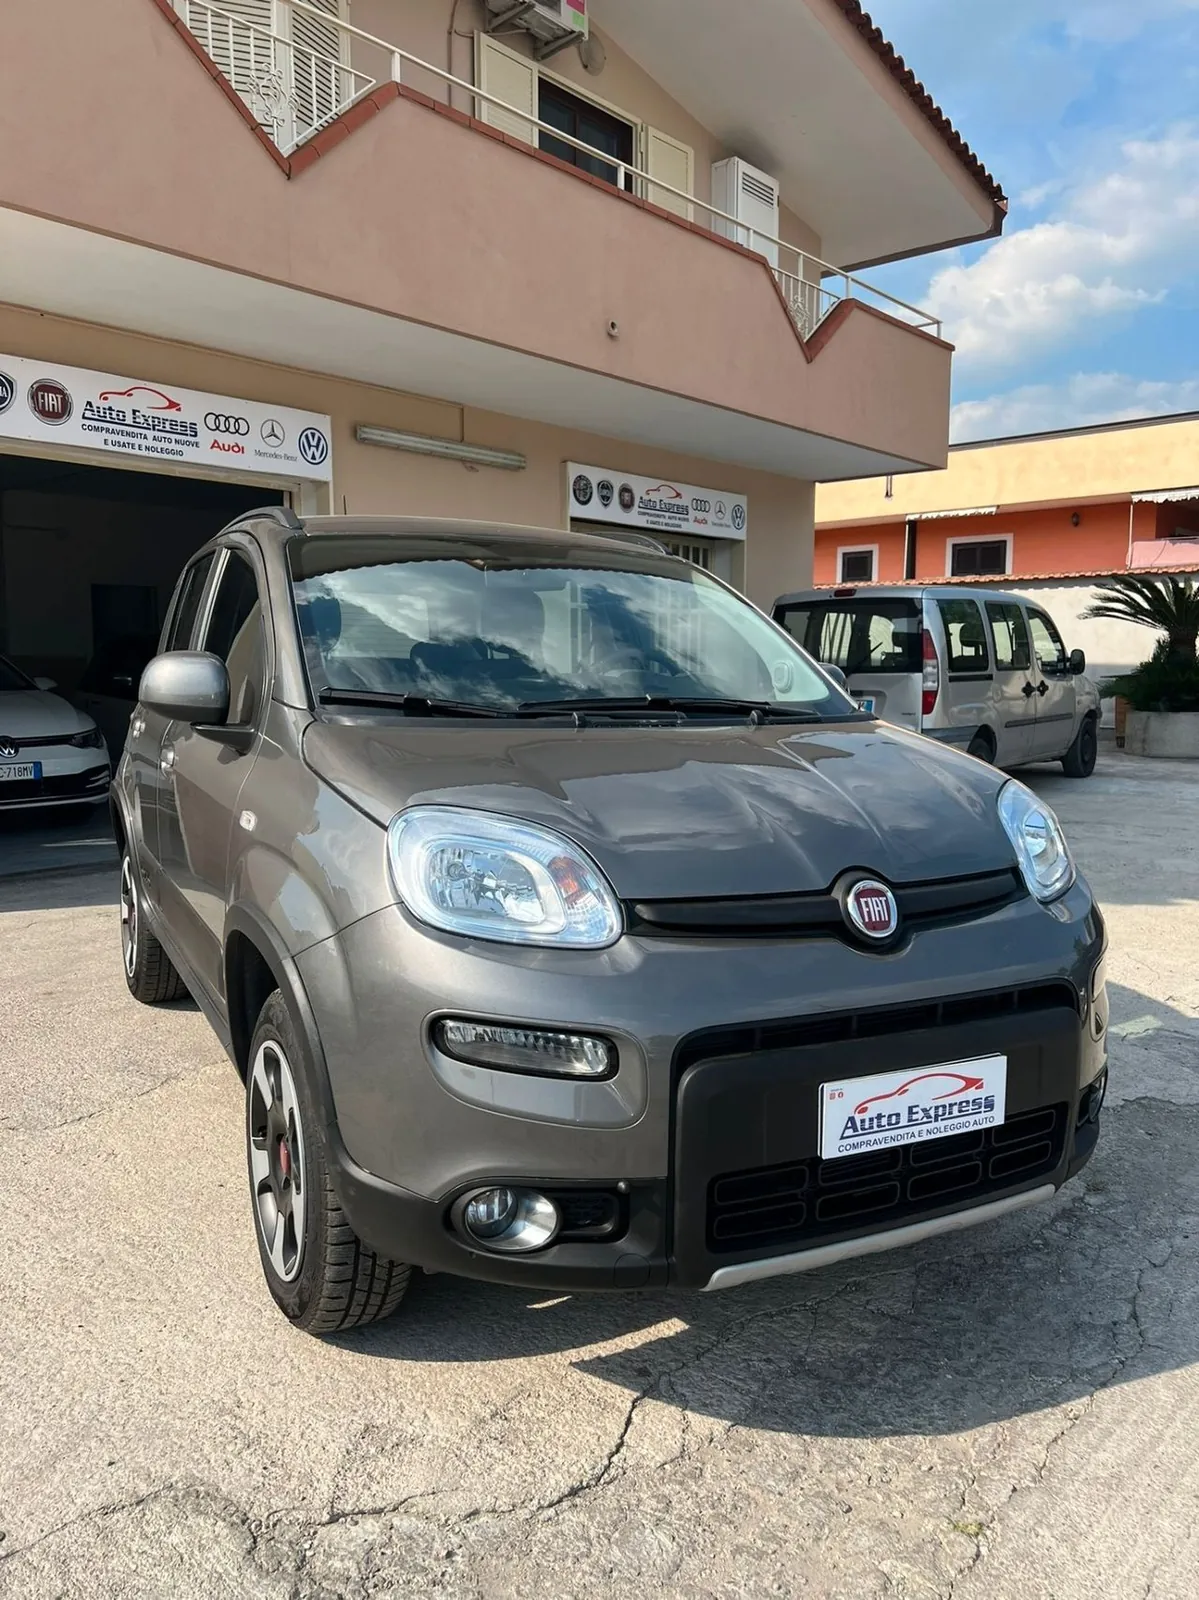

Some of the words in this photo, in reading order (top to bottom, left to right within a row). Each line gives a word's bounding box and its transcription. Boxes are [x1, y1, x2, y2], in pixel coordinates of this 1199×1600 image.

[37, 391, 64, 414] FIAT
[82, 400, 126, 423] Auto
[132, 408, 198, 438] Express
[81, 423, 149, 441] COMPRAVENDITA
[152, 434, 173, 445] AUTO
[174, 438, 200, 448] NUOVE
[103, 438, 109, 446] E
[111, 439, 136, 451] USATE
[144, 445, 184, 457] NOLEGGIO
[210, 439, 245, 454] Audi
[638, 496, 657, 509] Auto
[860, 896, 889, 922] FIAT
[839, 1112, 901, 1140] Auto
[906, 1094, 995, 1123] Express
[838, 1131, 916, 1153] COMPRAVENDITA
[918, 1128, 924, 1138] E
[926, 1120, 971, 1137] NOLEGGIO
[972, 1115, 995, 1127] AUTO
